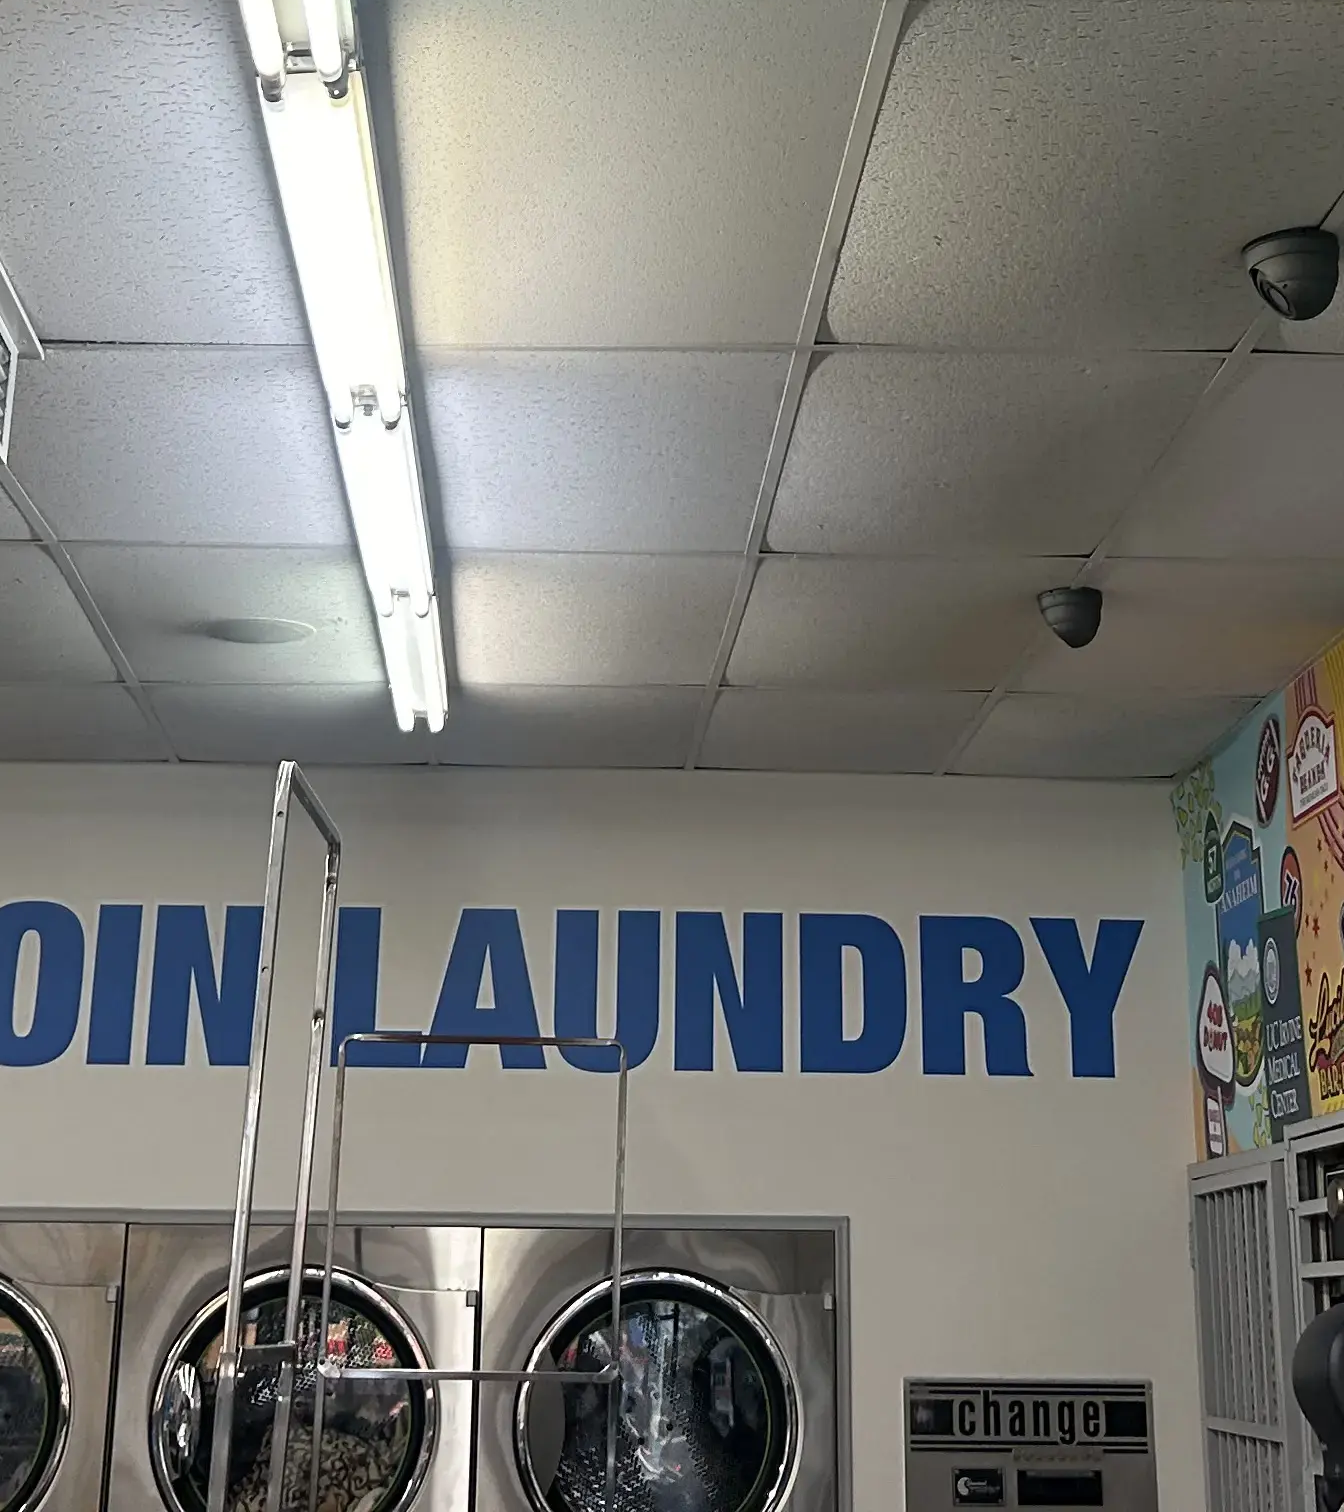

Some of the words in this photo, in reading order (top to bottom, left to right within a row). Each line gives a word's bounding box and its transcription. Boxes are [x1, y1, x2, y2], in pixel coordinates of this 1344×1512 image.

[1207, 845, 1218, 875] 57
[1220, 873, 1258, 915] ANAHEIM
[330, 906, 1146, 1078] LAUNDRY
[1267, 1052, 1301, 1086] MEDICAL
[1270, 1088, 1299, 1120] CENTER
[958, 1389, 1100, 1445] change
